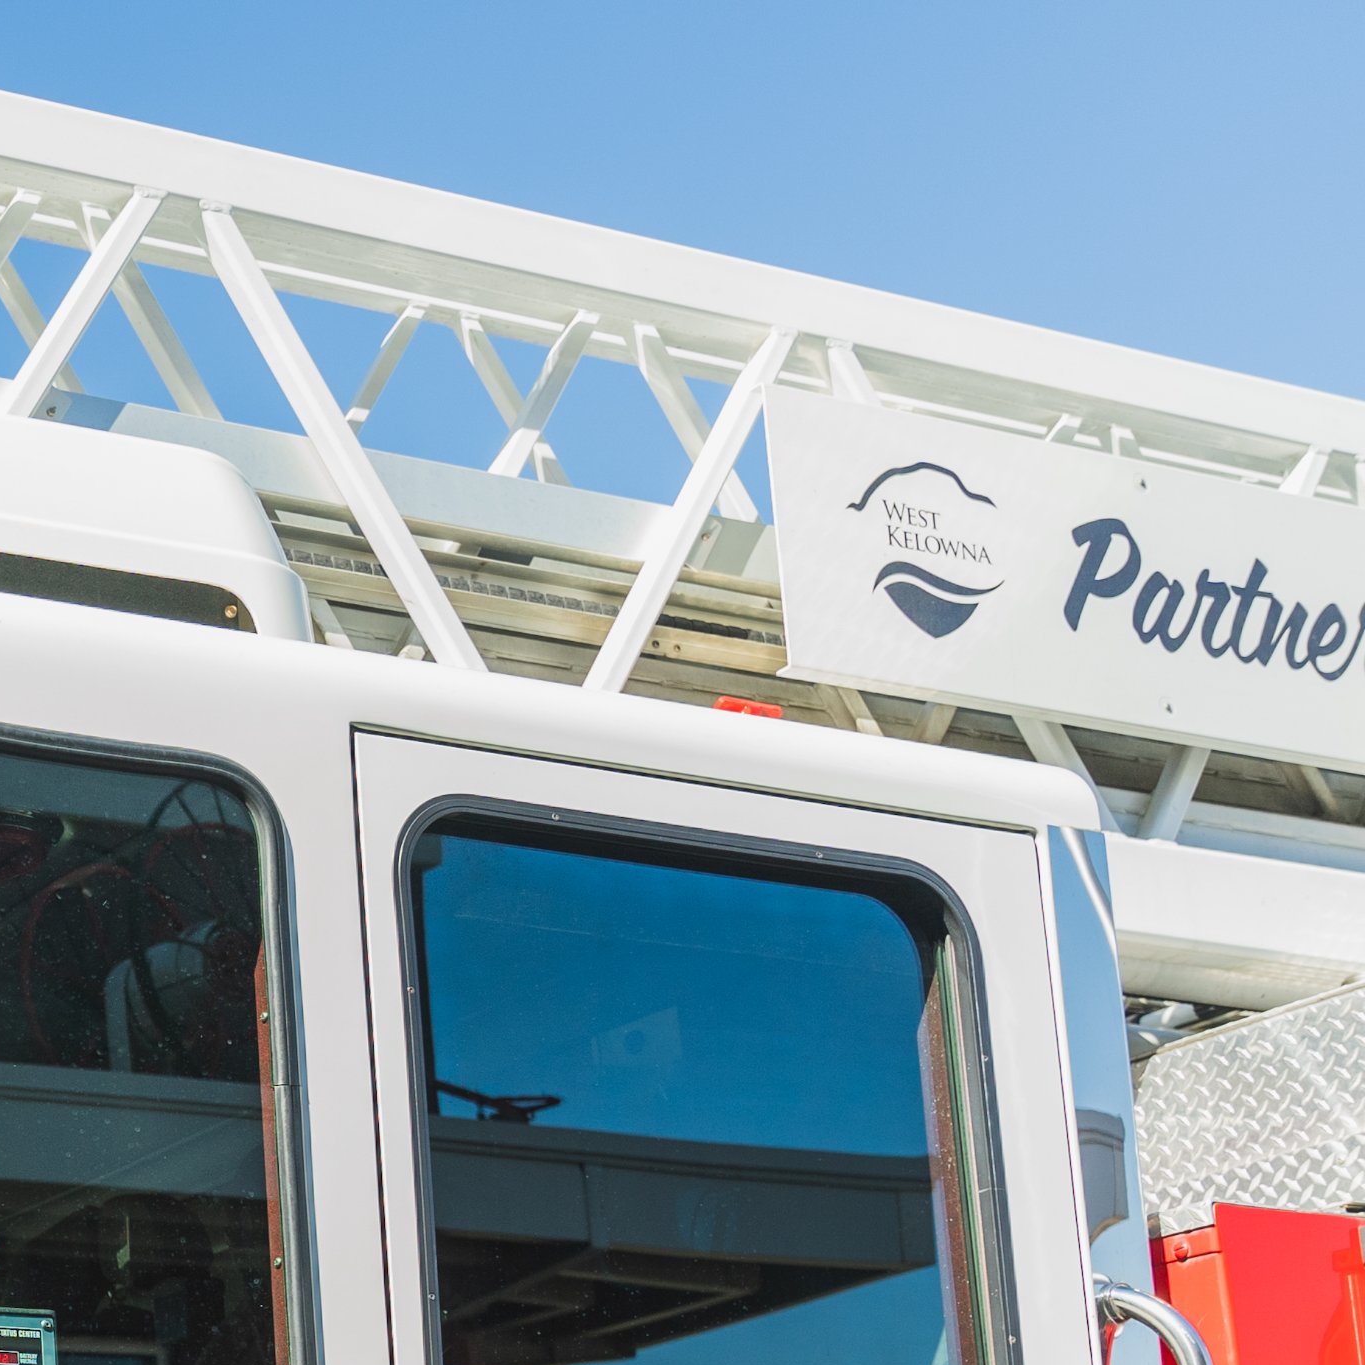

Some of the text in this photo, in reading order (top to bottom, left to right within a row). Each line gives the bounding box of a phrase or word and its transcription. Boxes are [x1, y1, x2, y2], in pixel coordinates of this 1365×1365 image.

[882, 499, 941, 531] WEST
[886, 524, 993, 567] KELOWNA
[18, 1330, 41, 1339] CENTER
